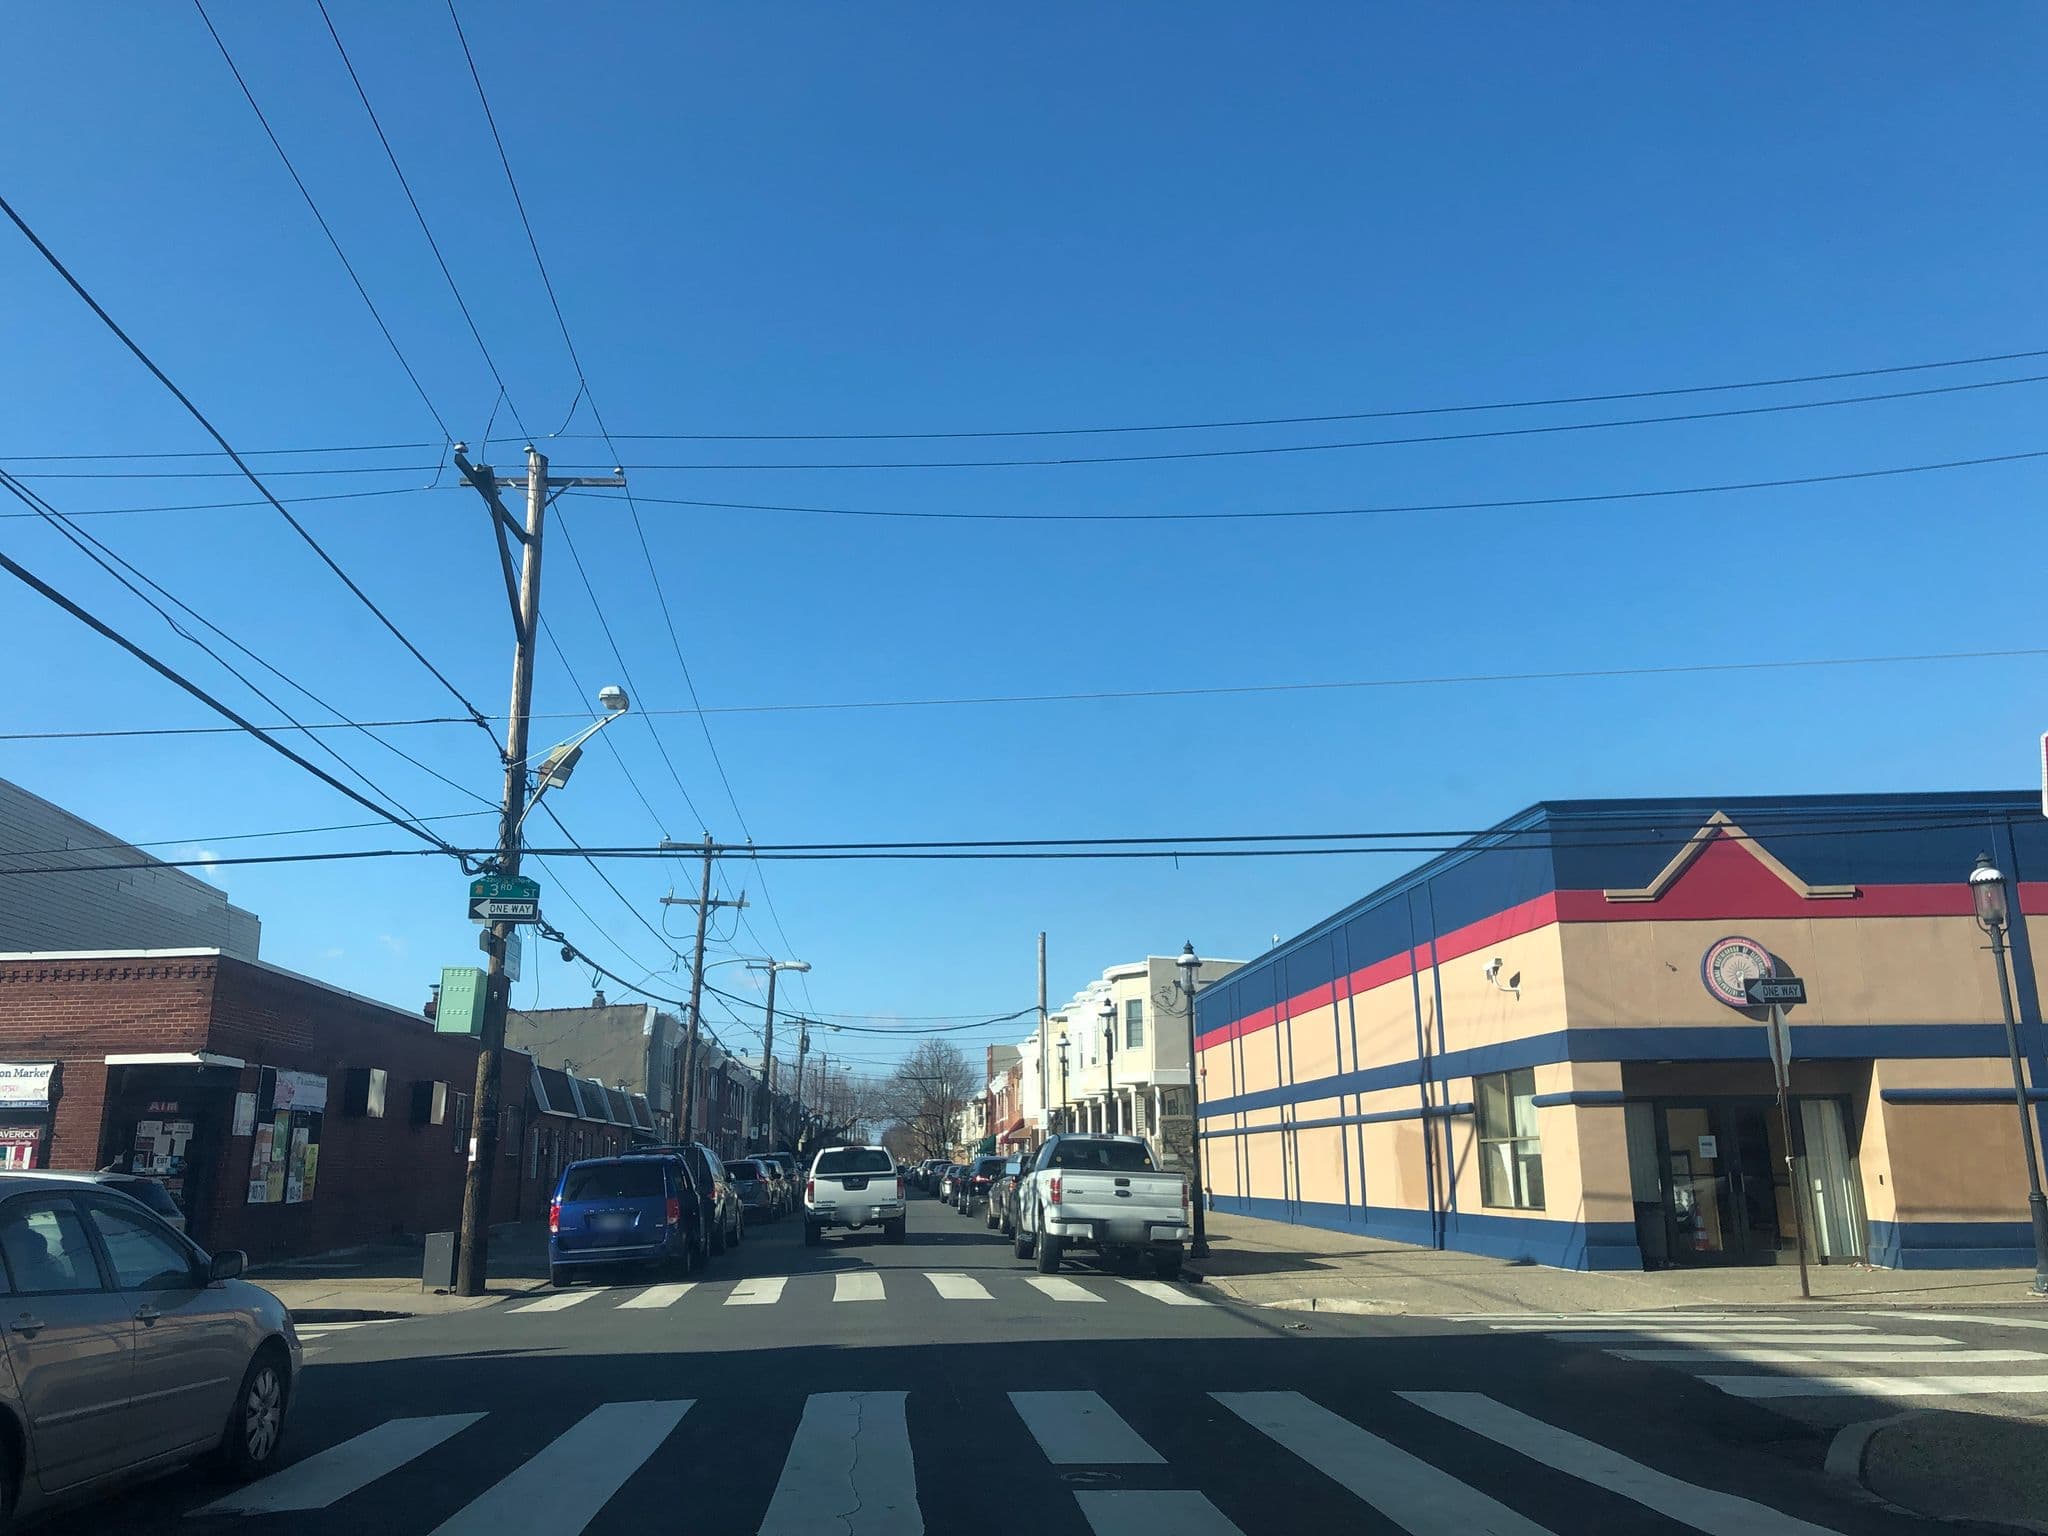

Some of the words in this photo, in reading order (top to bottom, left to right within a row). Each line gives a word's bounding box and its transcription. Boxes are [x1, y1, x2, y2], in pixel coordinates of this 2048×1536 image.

[523, 889, 536, 897] ST
[490, 905, 508, 913] ONE
[512, 905, 531, 913] WAY
[1763, 985, 1779, 996] ONE
[1781, 986, 1798, 996] WAY
[13, 1067, 49, 1078] Market
